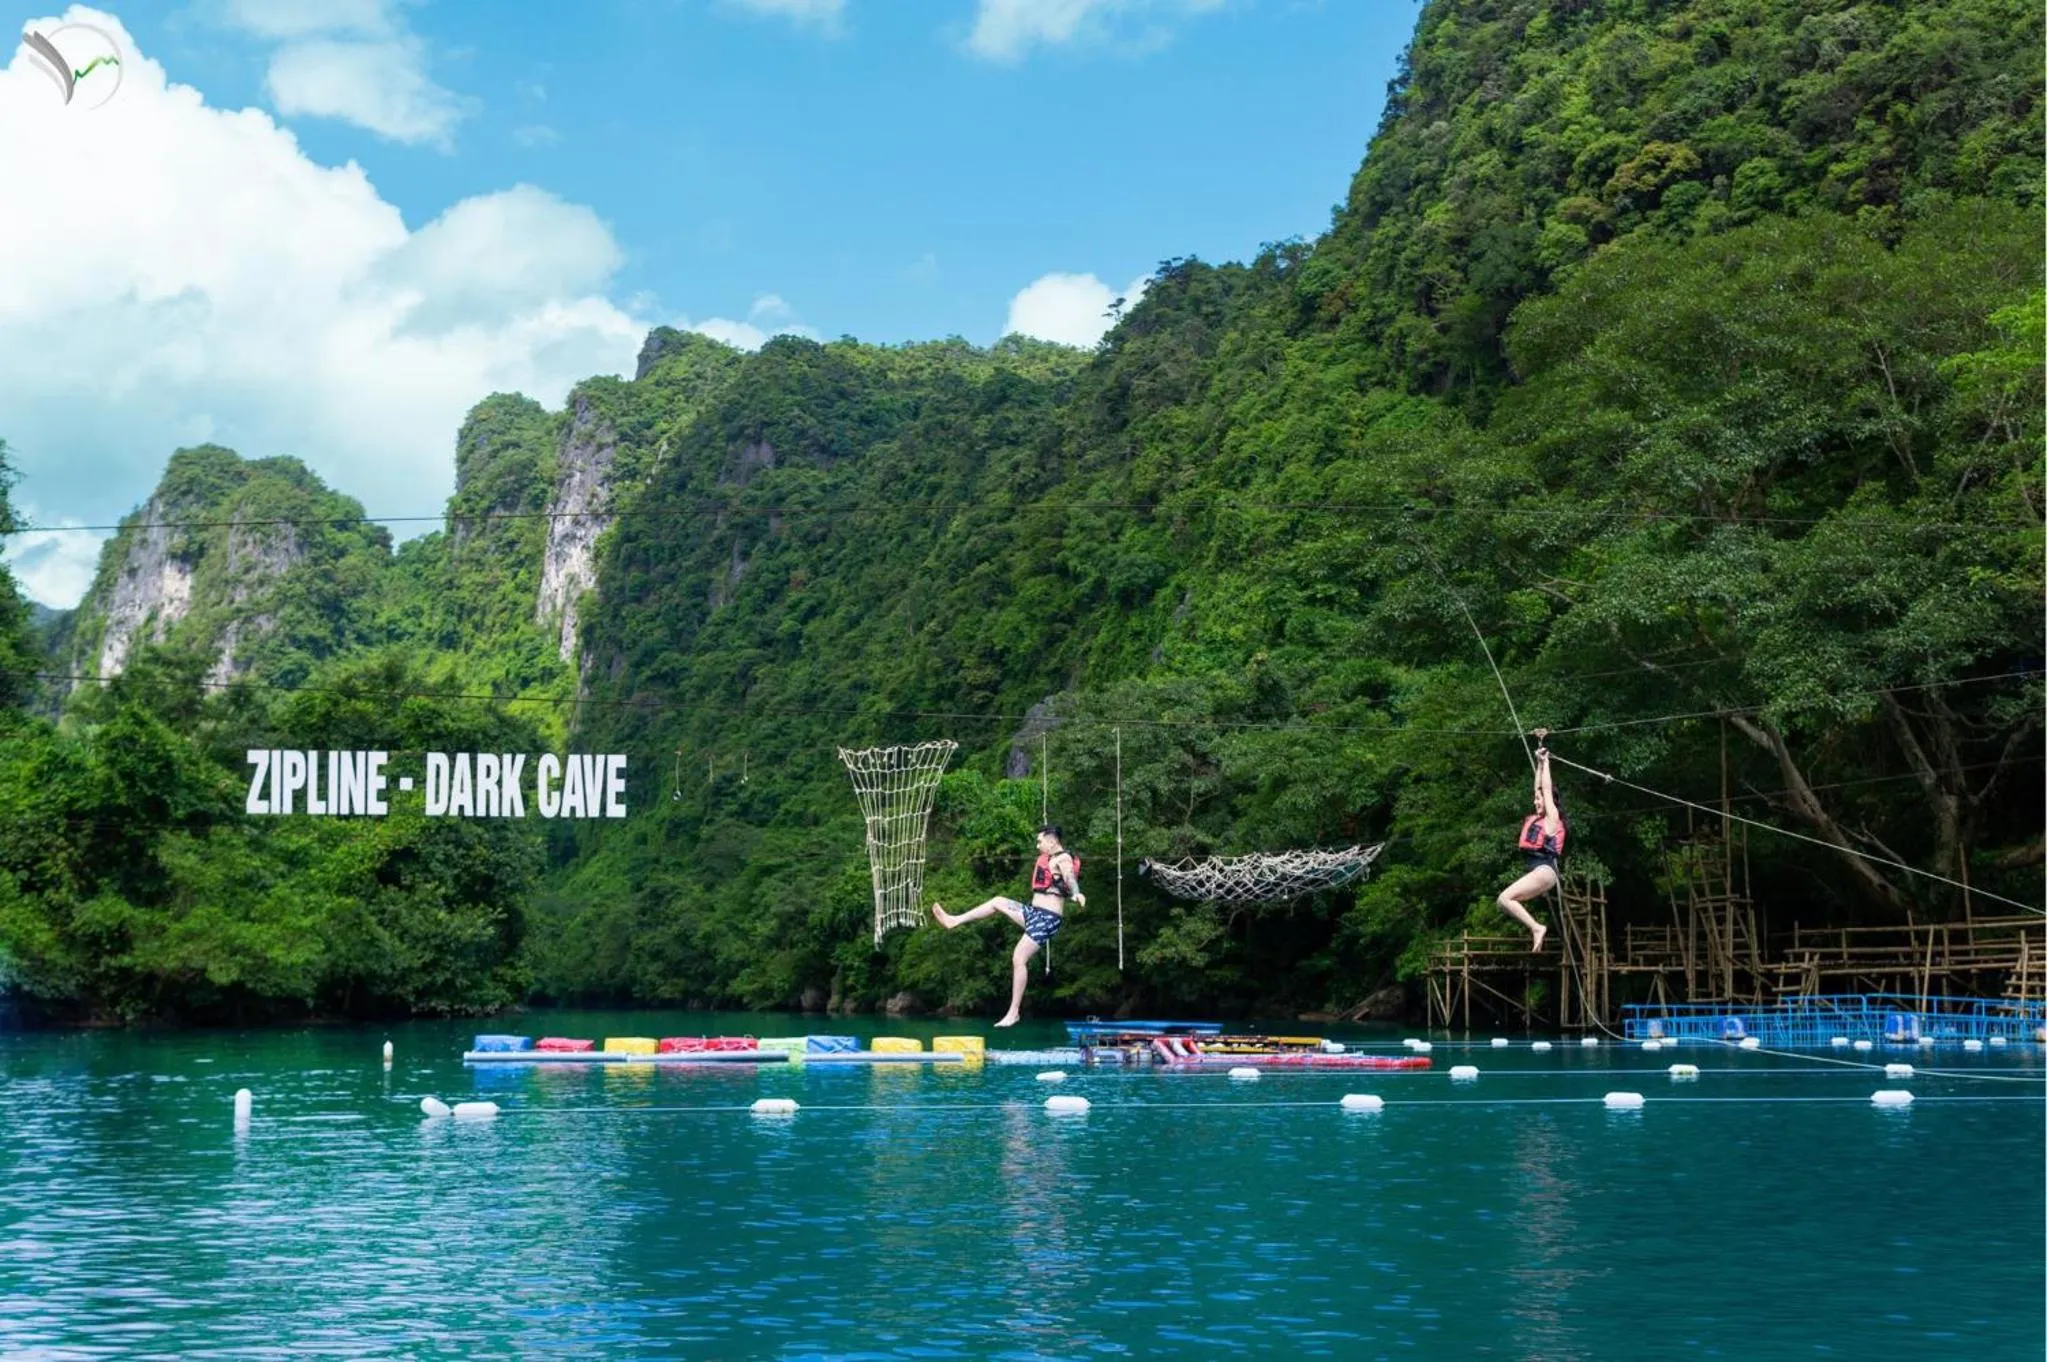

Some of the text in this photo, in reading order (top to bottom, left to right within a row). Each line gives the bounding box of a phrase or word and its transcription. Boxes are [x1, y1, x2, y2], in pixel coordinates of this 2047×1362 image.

[245, 749, 388, 816] ZIPLINE
[425, 751, 526, 818] DARK
[537, 752, 627, 818] CAVE
